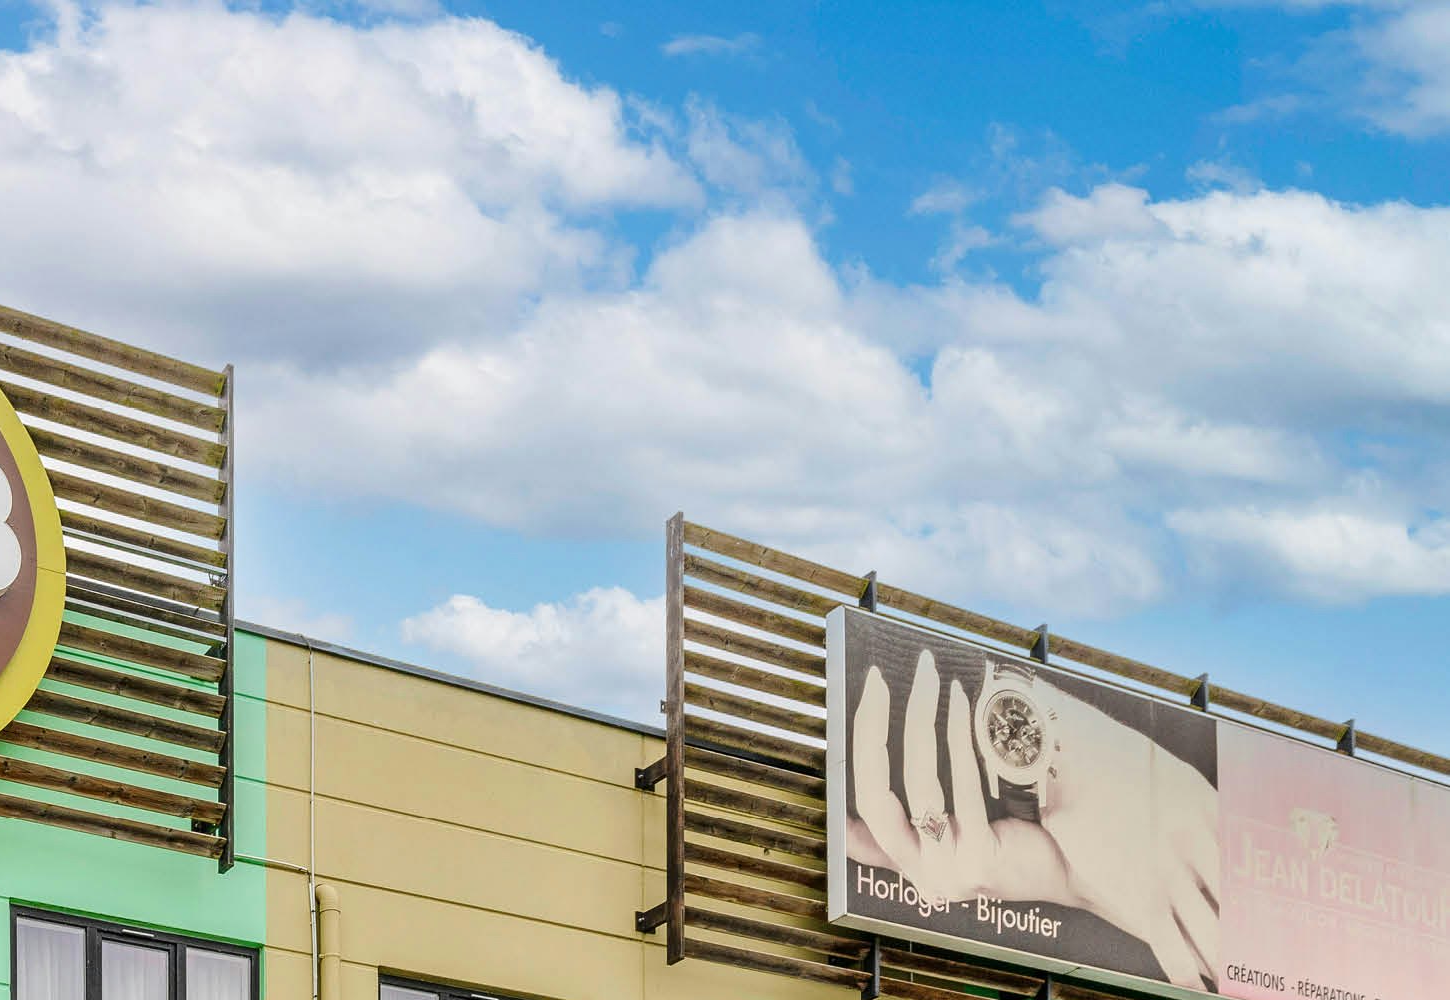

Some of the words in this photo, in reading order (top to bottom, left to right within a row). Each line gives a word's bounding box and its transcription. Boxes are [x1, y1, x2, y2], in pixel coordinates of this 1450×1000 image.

[1233, 831, 1309, 898] JEAN
[976, 893, 1063, 939] Bijoutier
[1226, 964, 1286, 992] CRÉATIONS
